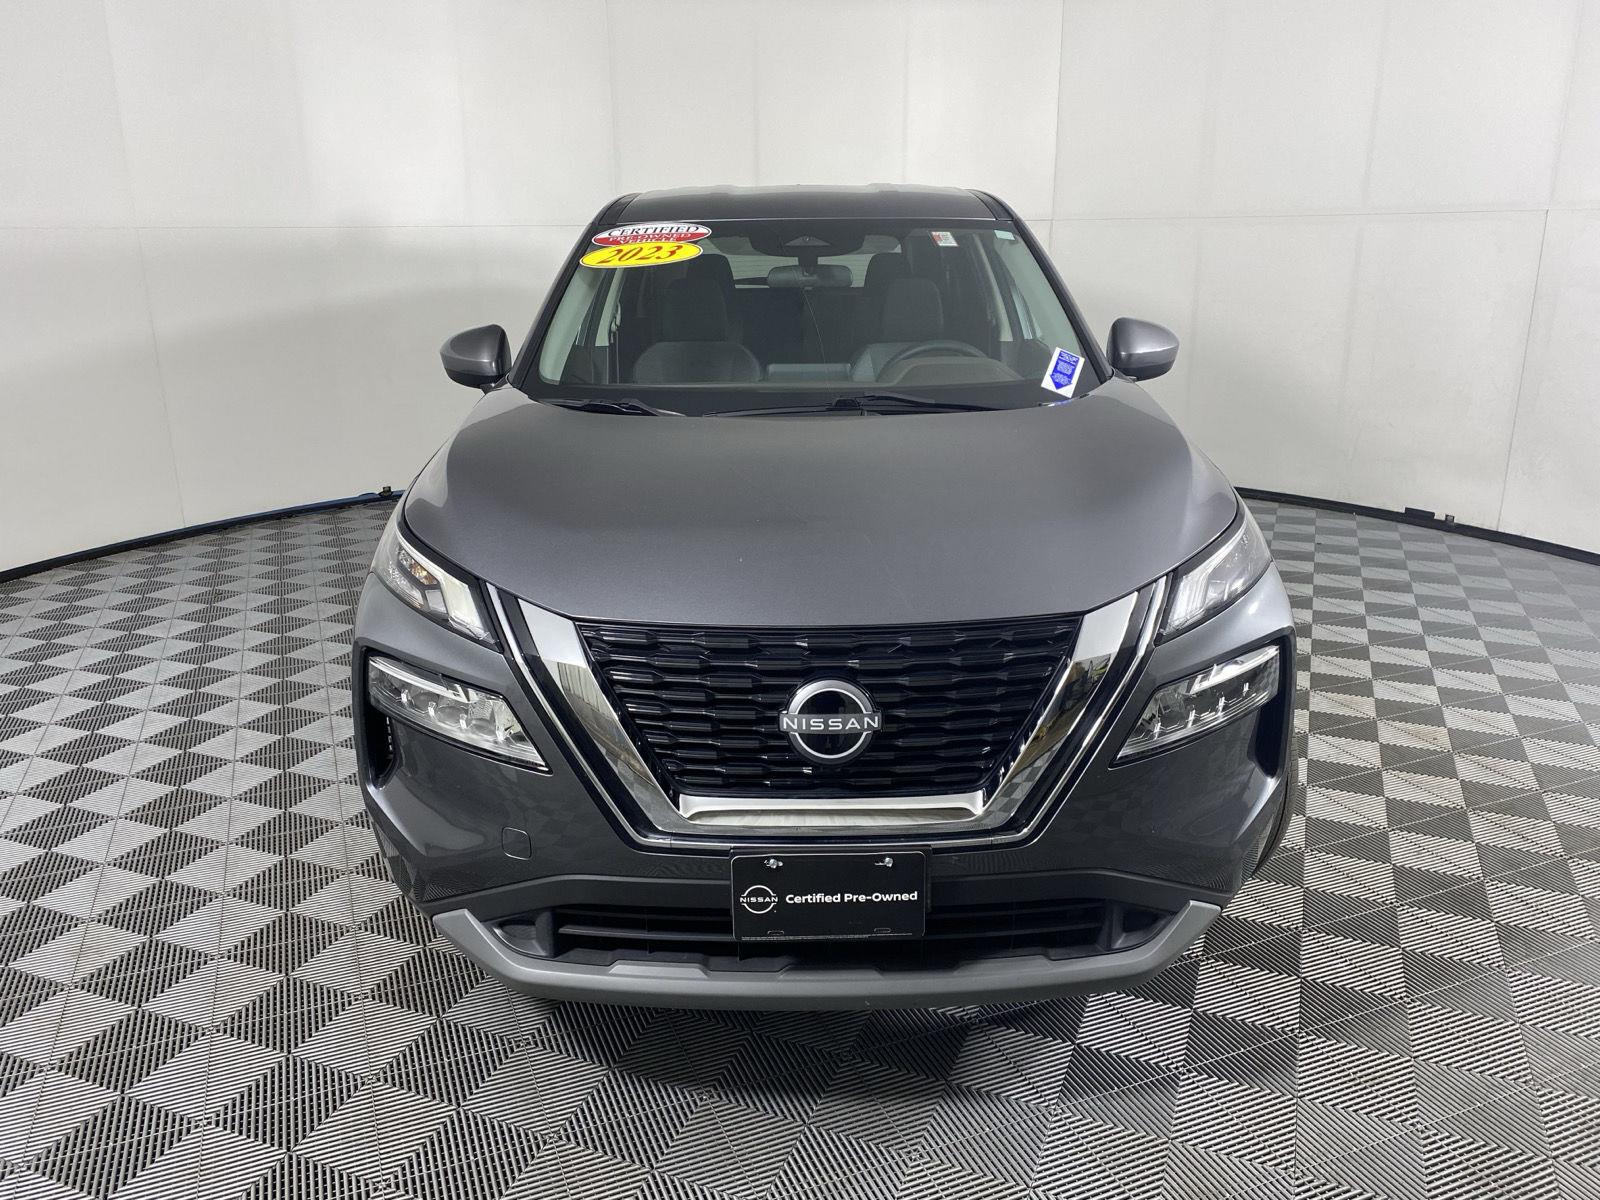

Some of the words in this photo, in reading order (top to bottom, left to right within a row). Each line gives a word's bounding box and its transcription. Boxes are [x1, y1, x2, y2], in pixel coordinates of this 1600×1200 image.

[609, 226, 699, 236] CERTIFIED
[596, 244, 683, 264] 2023
[783, 716, 879, 730] NISSAN
[785, 893, 841, 904] Certified
[844, 891, 918, 903] Pre-Owned
